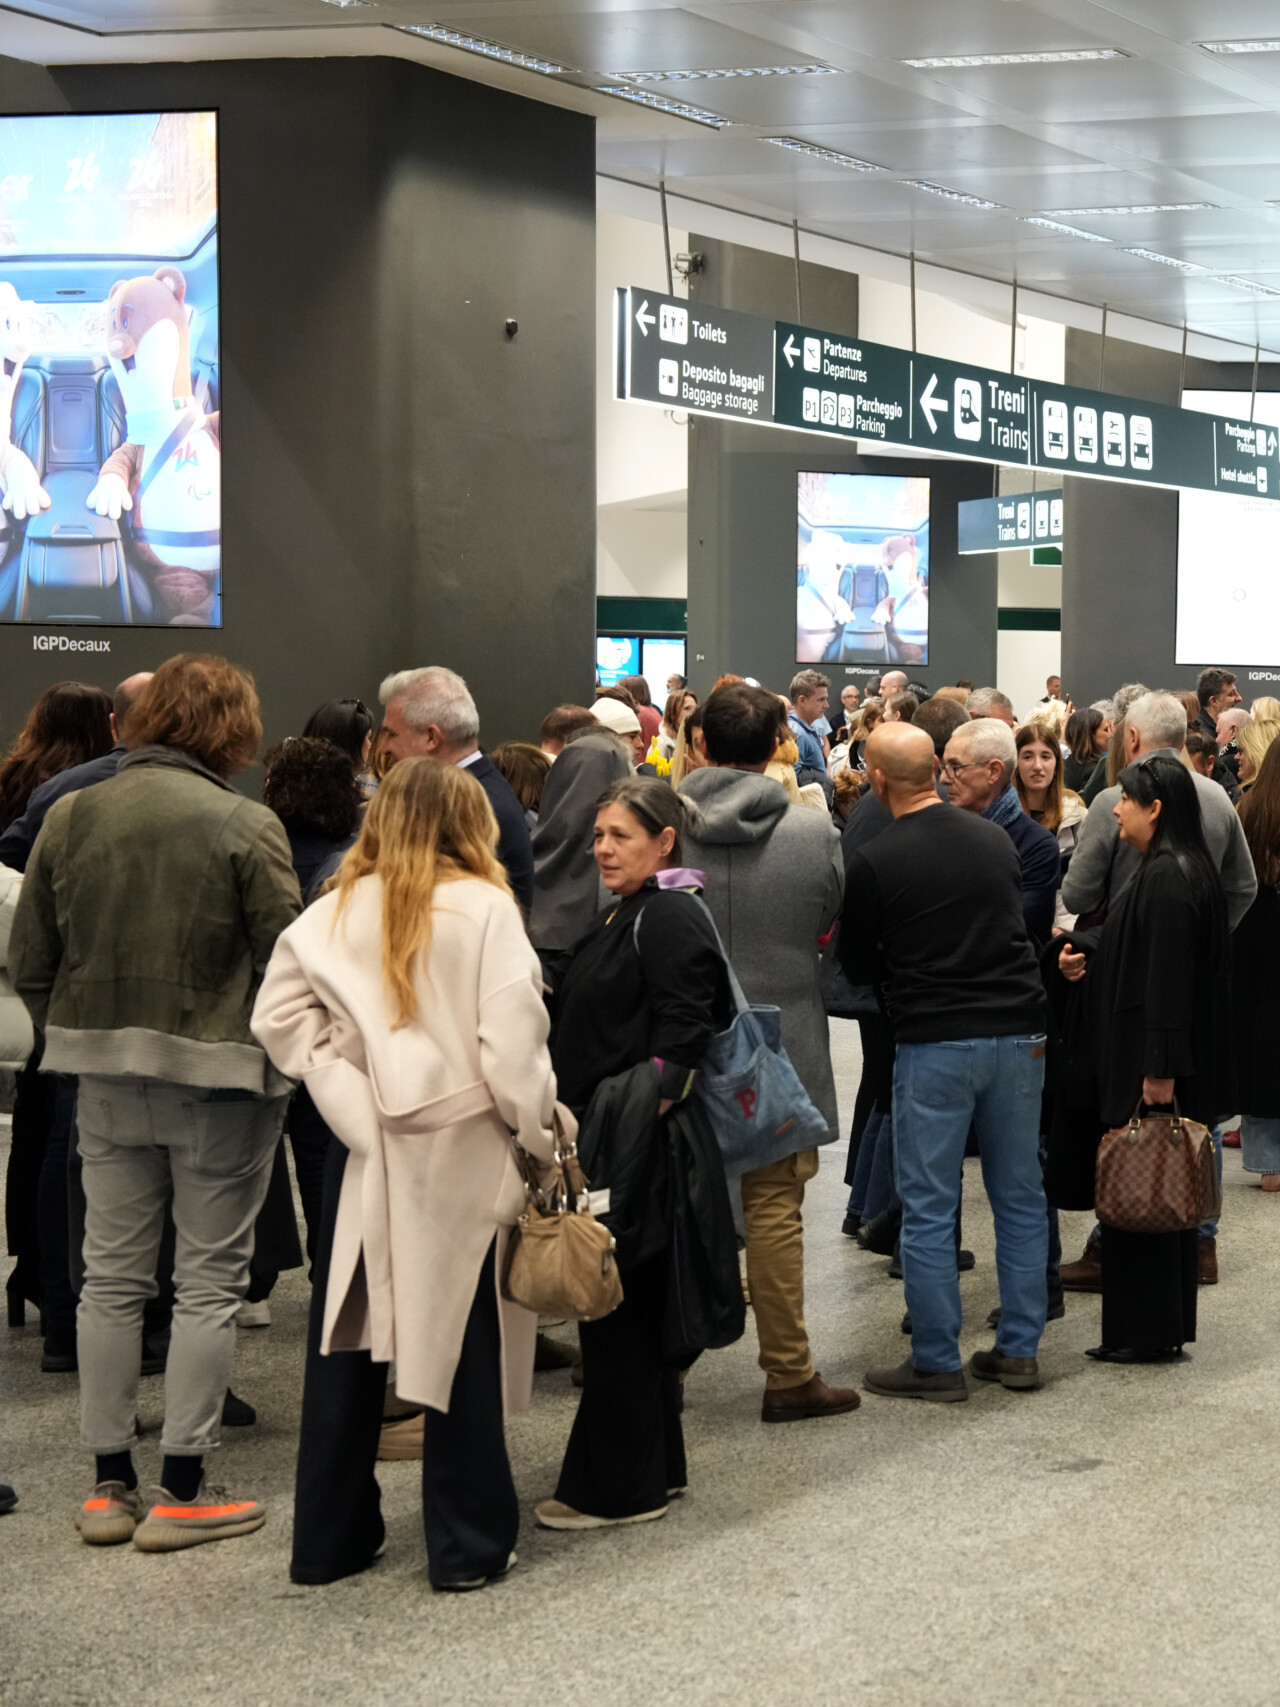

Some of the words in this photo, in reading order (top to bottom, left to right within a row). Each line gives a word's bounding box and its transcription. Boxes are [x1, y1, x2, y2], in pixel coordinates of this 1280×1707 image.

[692, 320, 727, 344] Toilets
[823, 338, 862, 362] Partenze
[682, 360, 728, 387] Deposito
[730, 366, 764, 396] bagagli
[823, 359, 868, 383] Departures
[682, 382, 723, 408] Baggage
[724, 391, 759, 416] storage
[805, 400, 817, 418] P1
[823, 403, 835, 421] P2
[841, 407, 853, 424] P3
[856, 394, 903, 421] Parcheggio
[988, 380, 1025, 415] Treni
[856, 414, 886, 438] Parking
[988, 417, 1029, 451] Trains
[1225, 422, 1255, 444] Parcheggio
[1236, 439, 1256, 457] Parking
[1221, 467, 1237, 482] Hotel
[1237, 469, 1256, 485] shuttle
[998, 502, 1015, 521] Treni
[997, 524, 1017, 541] Trains
[33, 635, 111, 652] IGPDecaux
[845, 667, 880, 675] IGPDecaux
[736, 1088, 757, 1118] P
